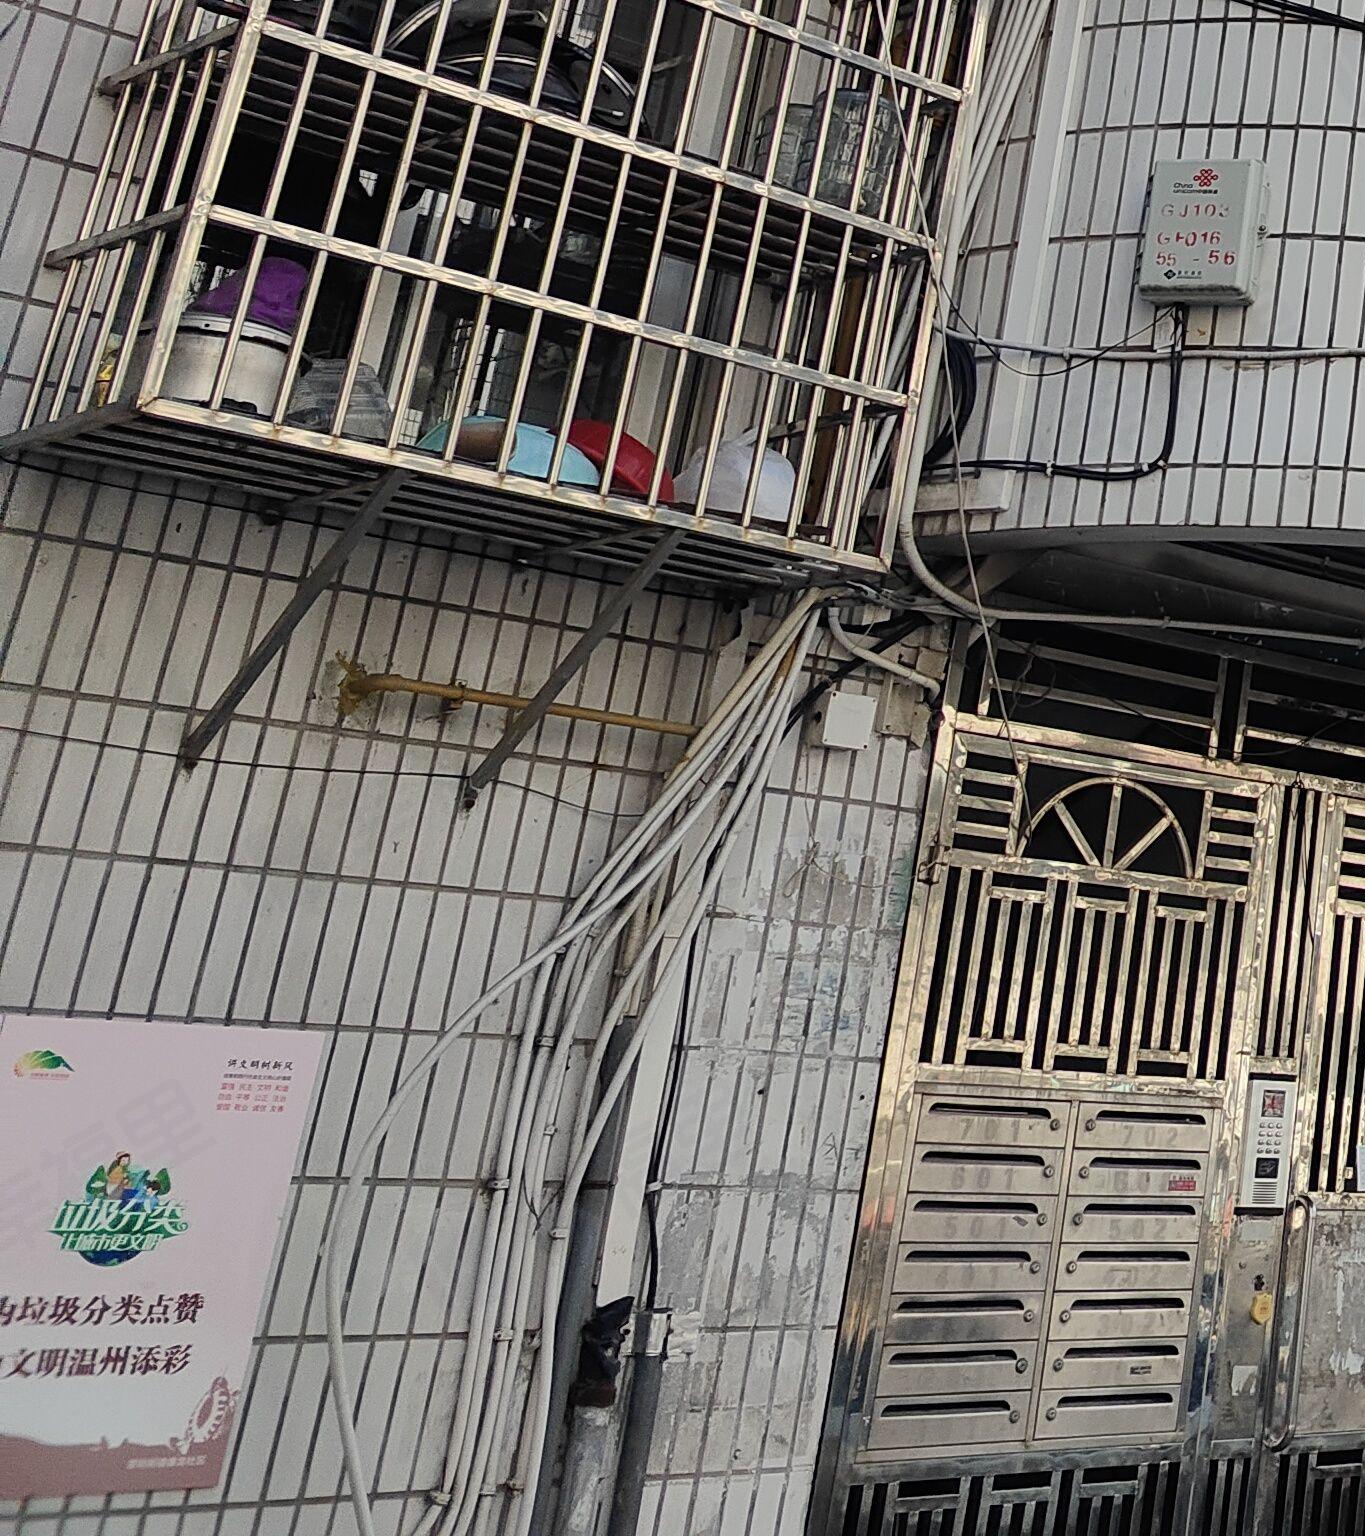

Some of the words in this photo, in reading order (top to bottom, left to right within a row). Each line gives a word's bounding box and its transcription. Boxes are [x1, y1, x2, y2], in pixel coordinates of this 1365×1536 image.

[0, 1343, 193, 1379] 文明温州添彩
